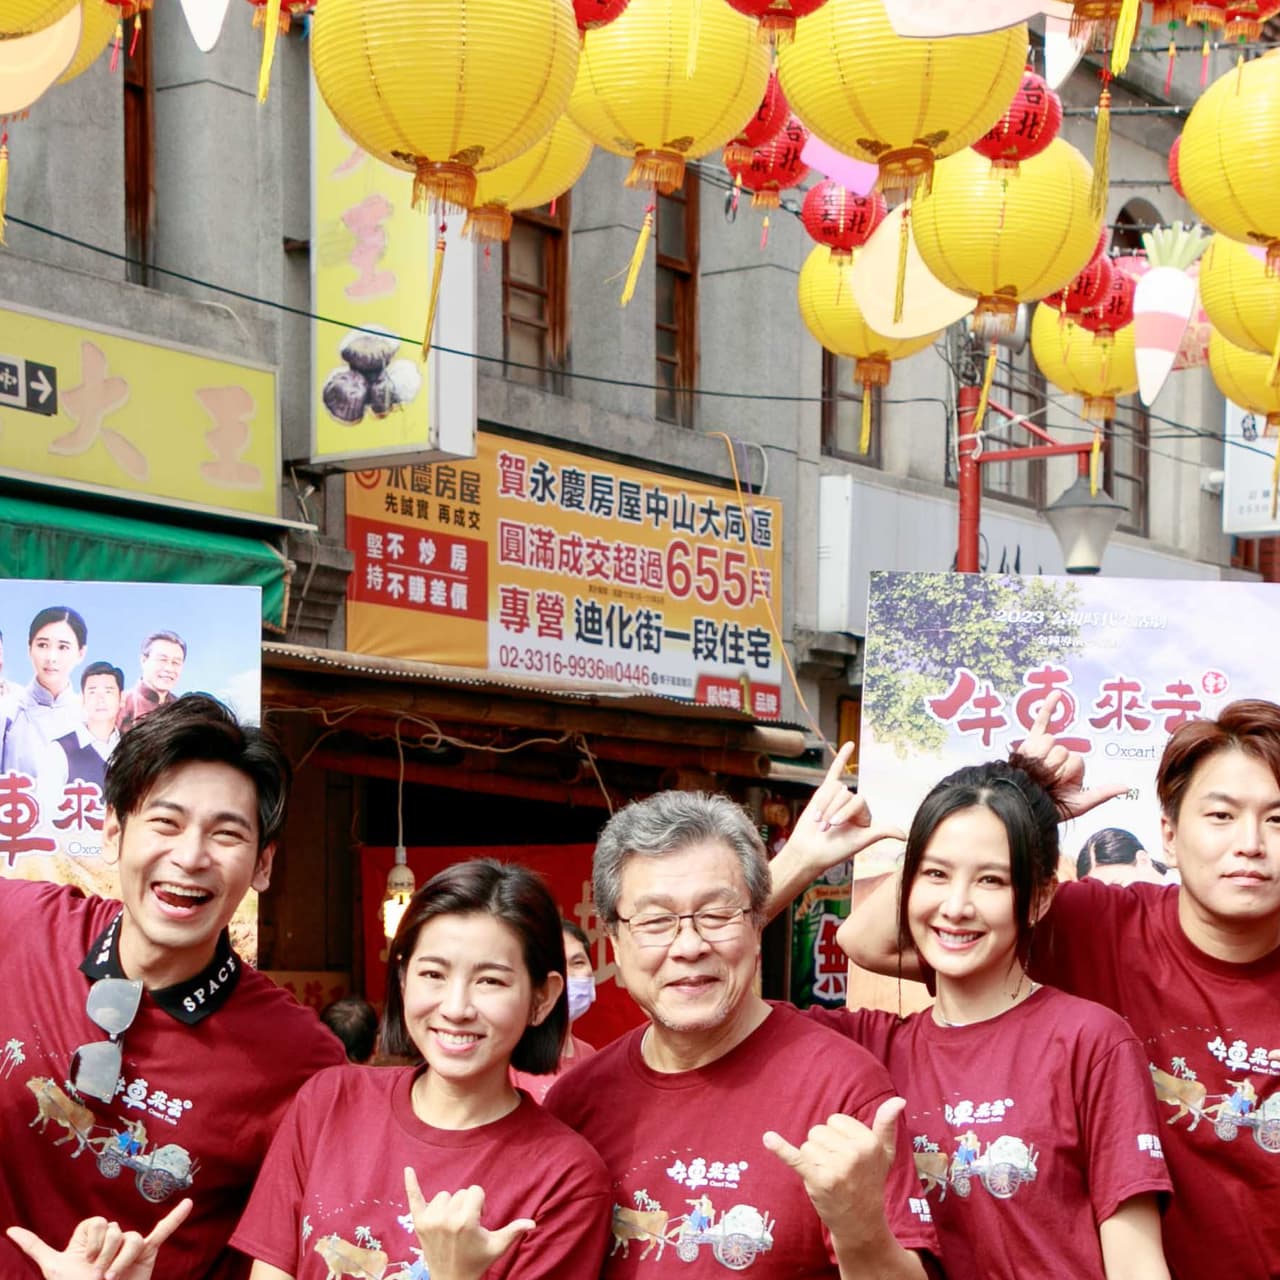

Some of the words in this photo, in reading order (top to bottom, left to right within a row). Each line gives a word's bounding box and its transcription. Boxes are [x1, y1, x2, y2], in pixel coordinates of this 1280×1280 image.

[386, 463, 481, 506] 永慶房屋
[385, 492, 429, 521] 先誠實
[438, 503, 481, 531] 再成交
[574, 597, 771, 669] 迪化街一段住宅
[996, 609, 1044, 624] 2023
[1104, 741, 1157, 759] Oxcart
